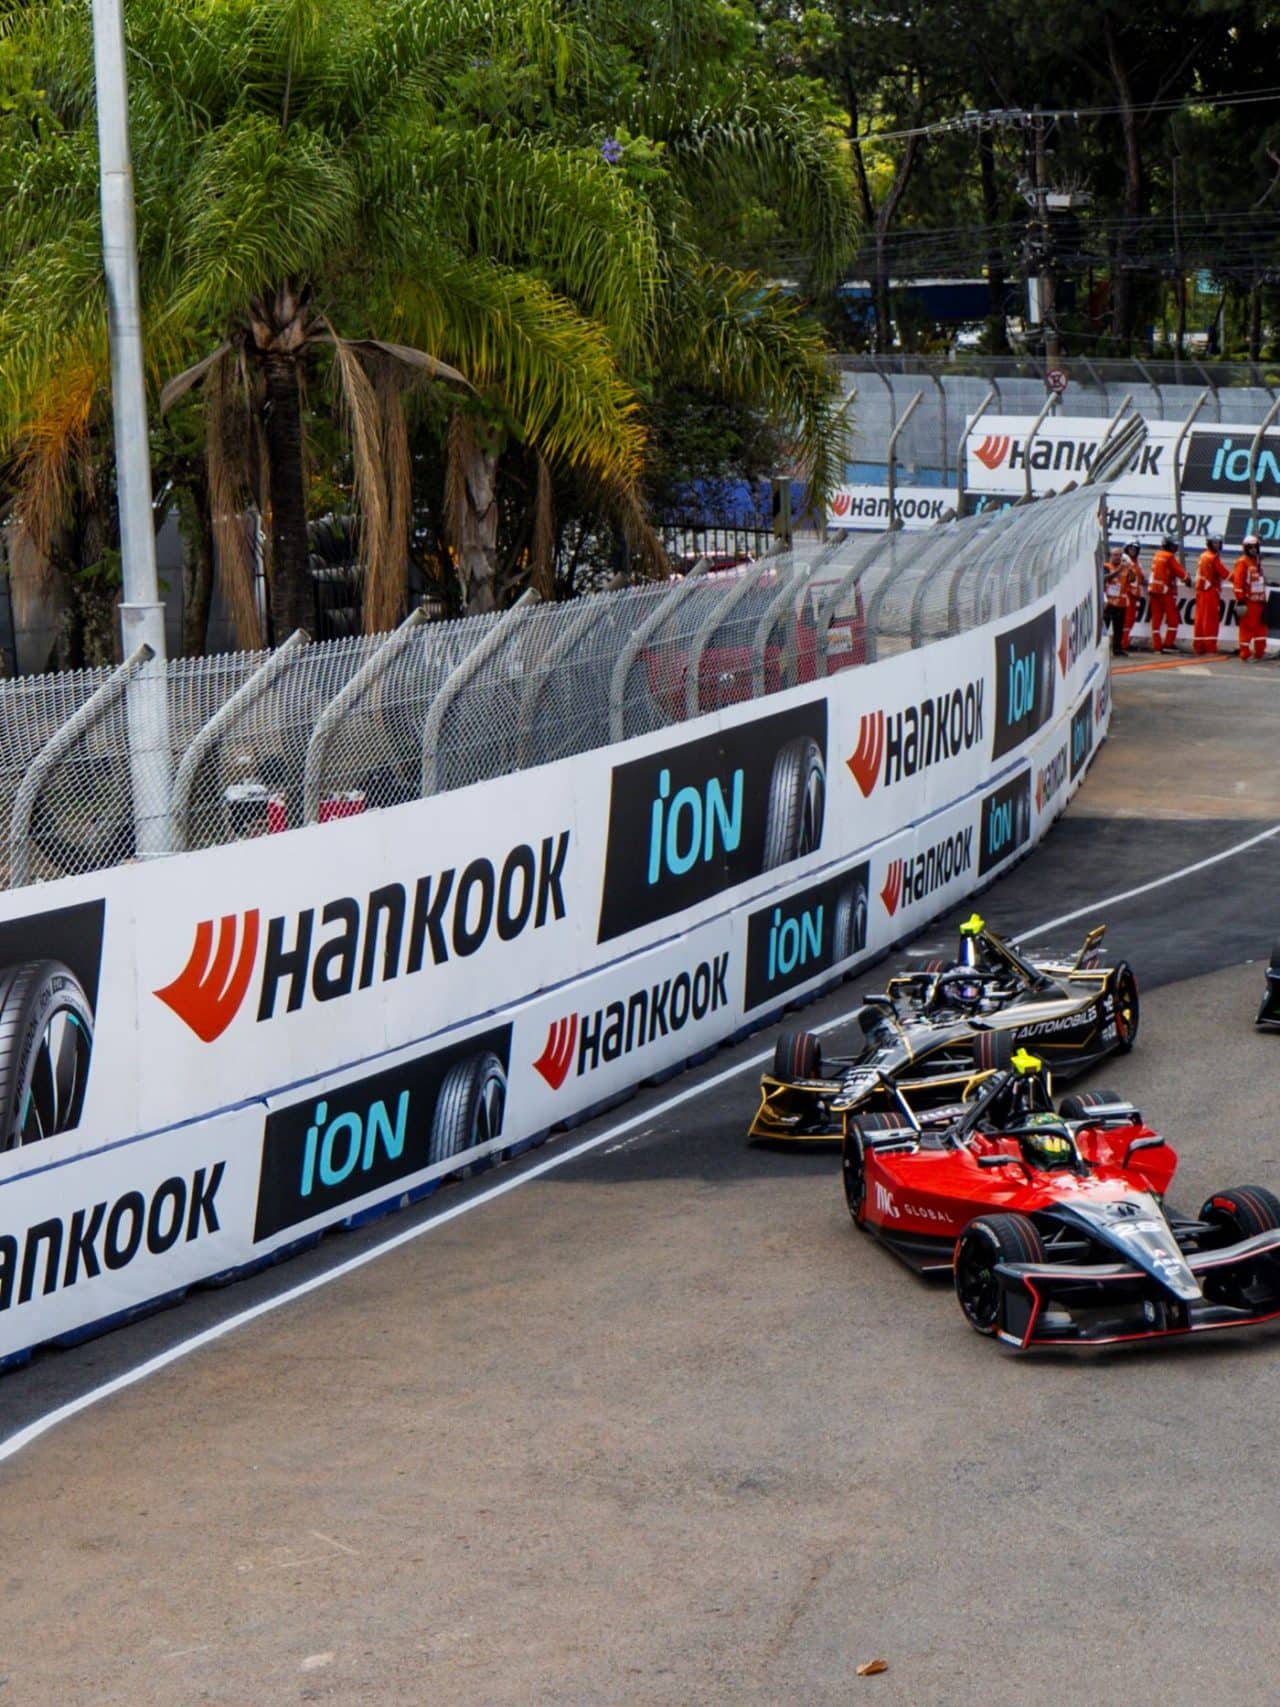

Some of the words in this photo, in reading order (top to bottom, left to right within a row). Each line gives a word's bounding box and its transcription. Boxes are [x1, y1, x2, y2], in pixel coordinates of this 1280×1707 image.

[1008, 643, 1035, 726] iON
[648, 768, 744, 885] iON
[989, 797, 1012, 855] iON
[767, 904, 824, 982] iON
[299, 1090, 409, 1196] iON
[903, 1203, 955, 1223] GLOBAL
